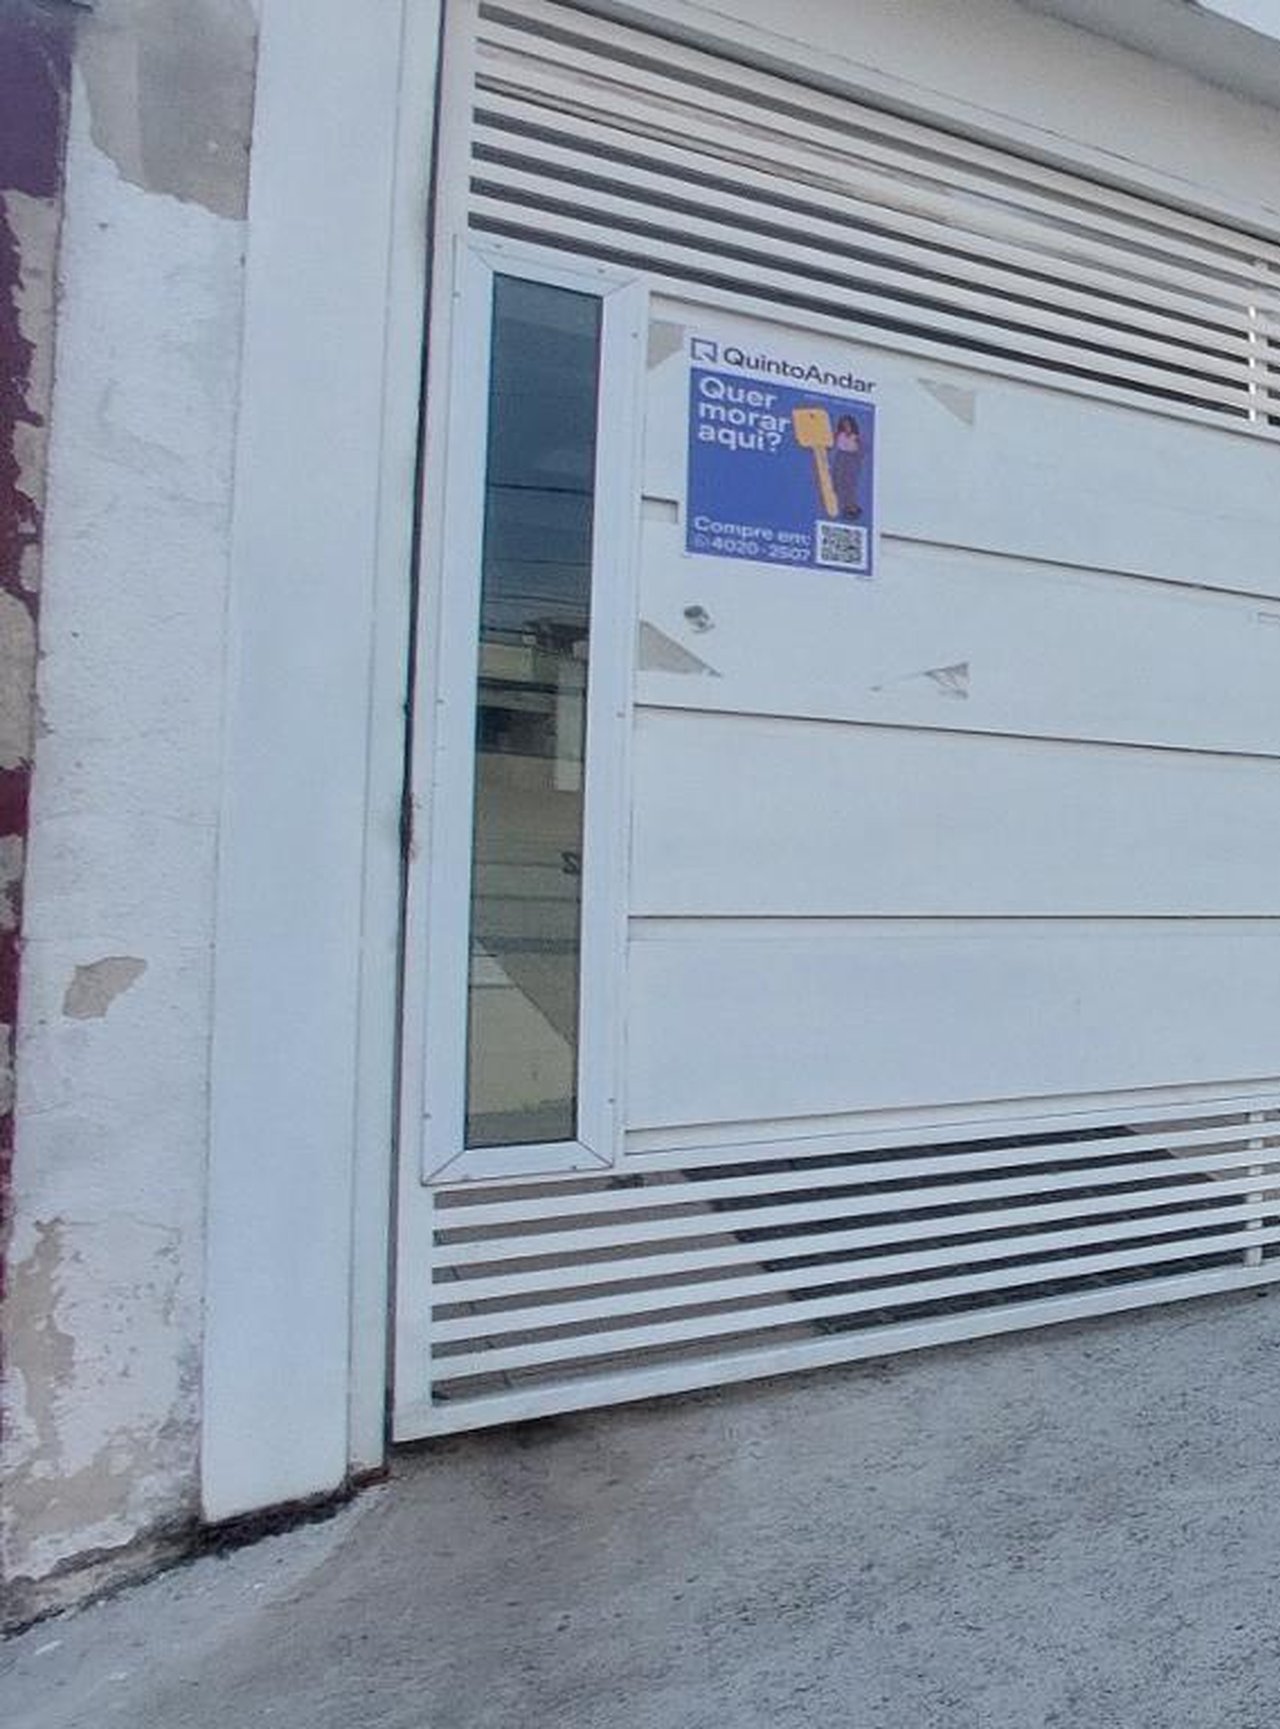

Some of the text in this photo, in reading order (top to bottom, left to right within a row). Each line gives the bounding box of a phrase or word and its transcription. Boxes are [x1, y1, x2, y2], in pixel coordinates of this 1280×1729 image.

[724, 348, 876, 393] QuintoAndar
[700, 377, 778, 409] Quer
[699, 403, 791, 433] morar
[698, 424, 783, 453] aqui?
[694, 515, 774, 543] Compre
